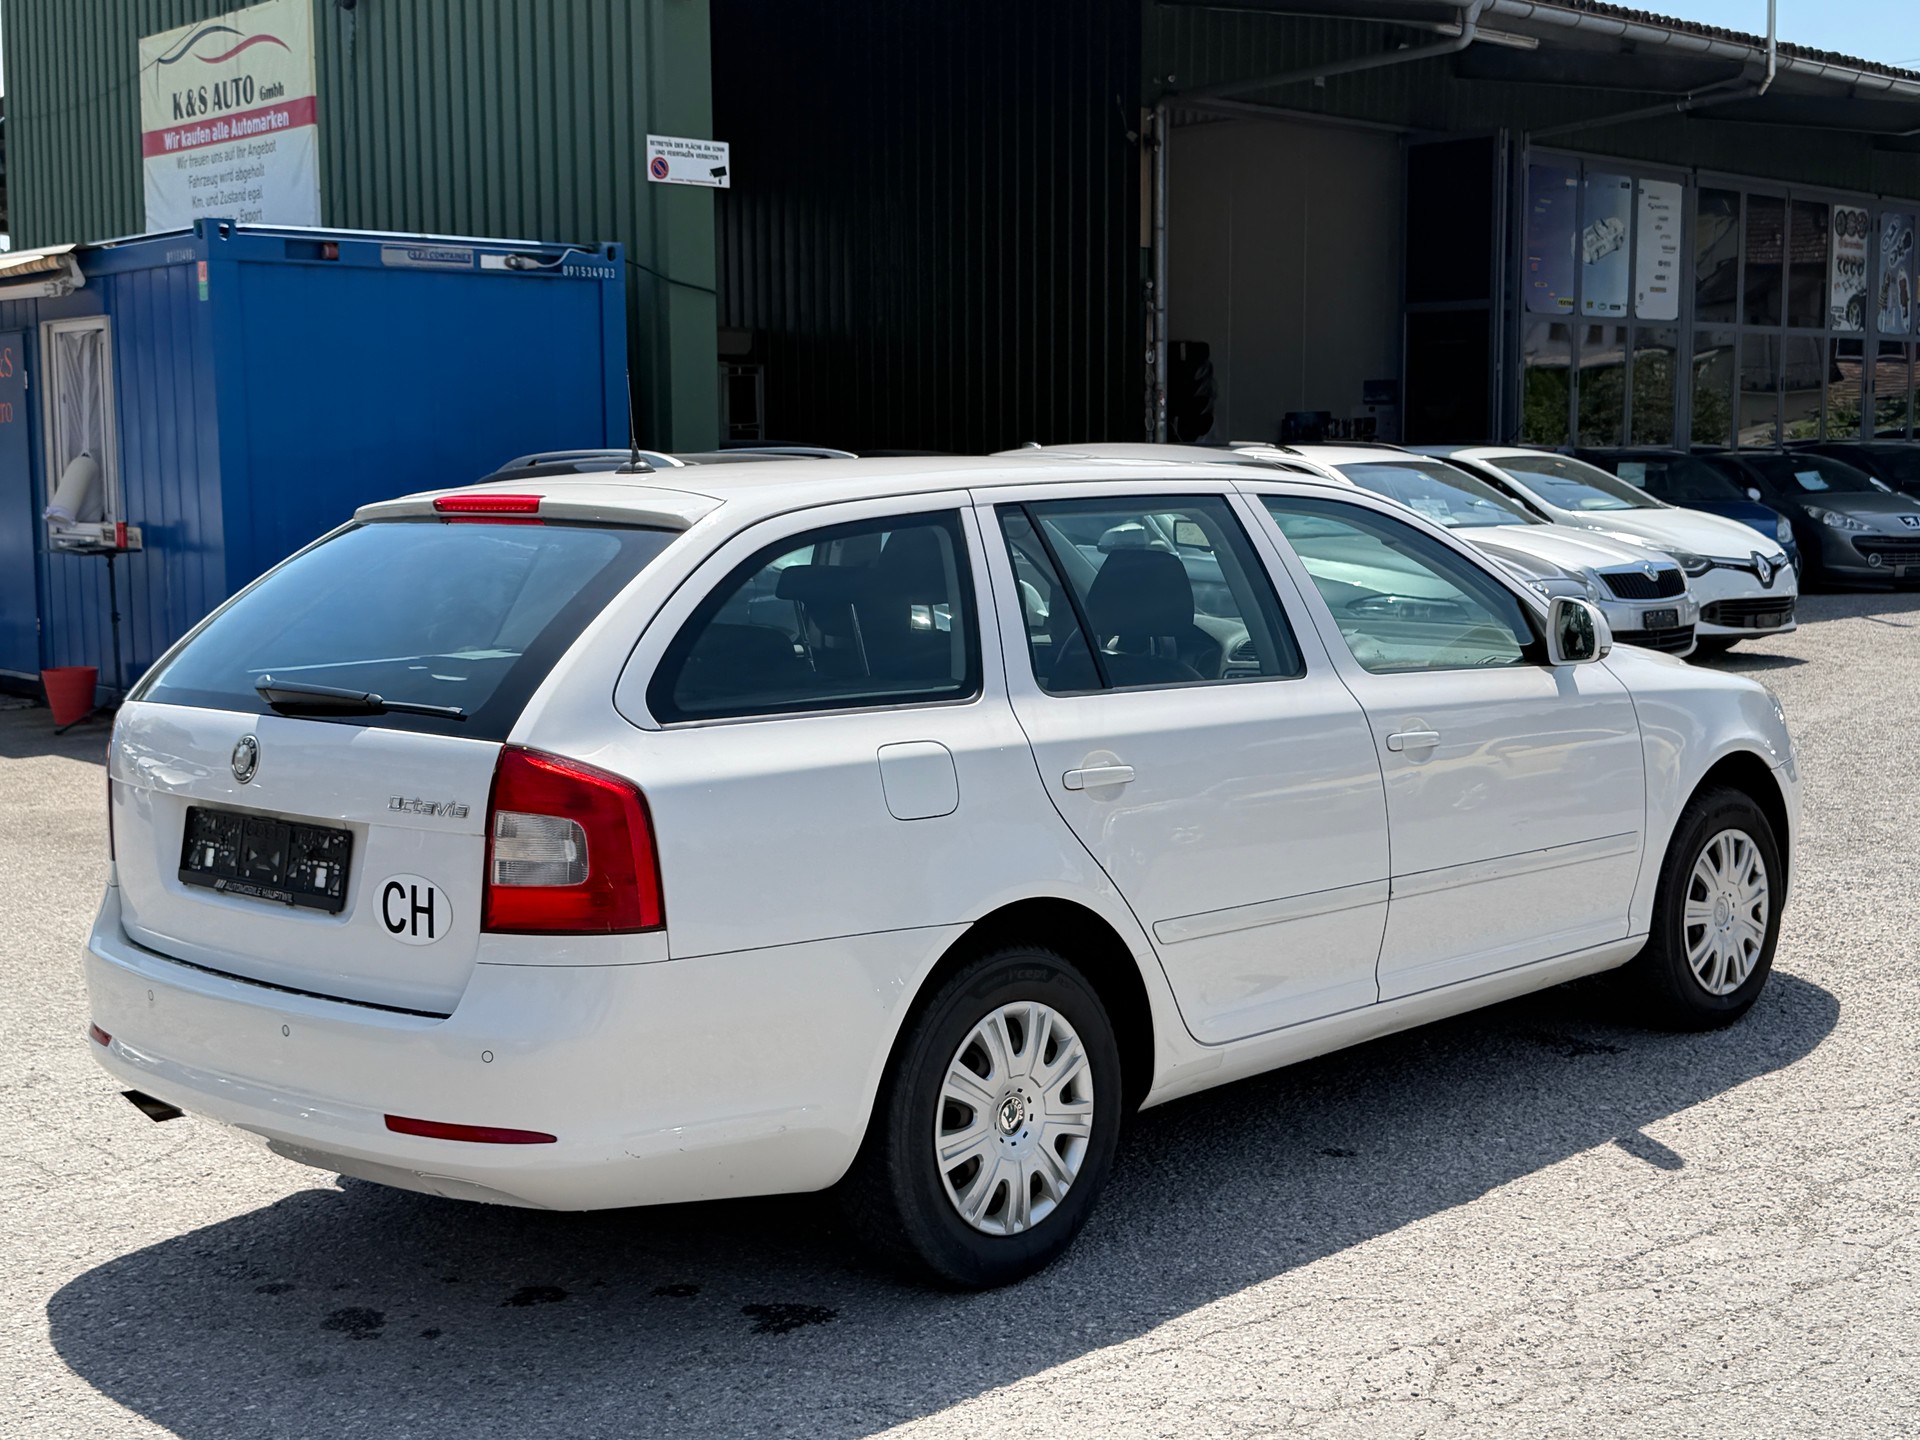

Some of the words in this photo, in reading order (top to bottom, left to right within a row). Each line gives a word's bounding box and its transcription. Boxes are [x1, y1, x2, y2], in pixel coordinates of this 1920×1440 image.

[172, 86, 208, 120] K&S
[213, 74, 255, 112] AUTO
[164, 131, 180, 151] Wir
[181, 126, 211, 148] kaufen
[212, 121, 230, 141] alle
[231, 110, 290, 138] Automarken
[176, 156, 188, 170] Wir
[189, 153, 210, 169] freuen
[211, 151, 223, 164] uns
[224, 147, 235, 161] auf
[236, 145, 247, 160] Ihr
[247, 140, 277, 160] Angebot
[188, 173, 219, 190] Fahrzeug
[219, 168, 234, 183] wird
[235, 163, 266, 184] abgeholt
[206, 193, 219, 206] und
[220, 187, 247, 205] Zustand
[247, 185, 264, 204] egal
[239, 208, 264, 224] Export
[387, 795, 471, 819] Octavia
[225, 881, 262, 897] AUTOMOBILE
[382, 880, 435, 939] CH
